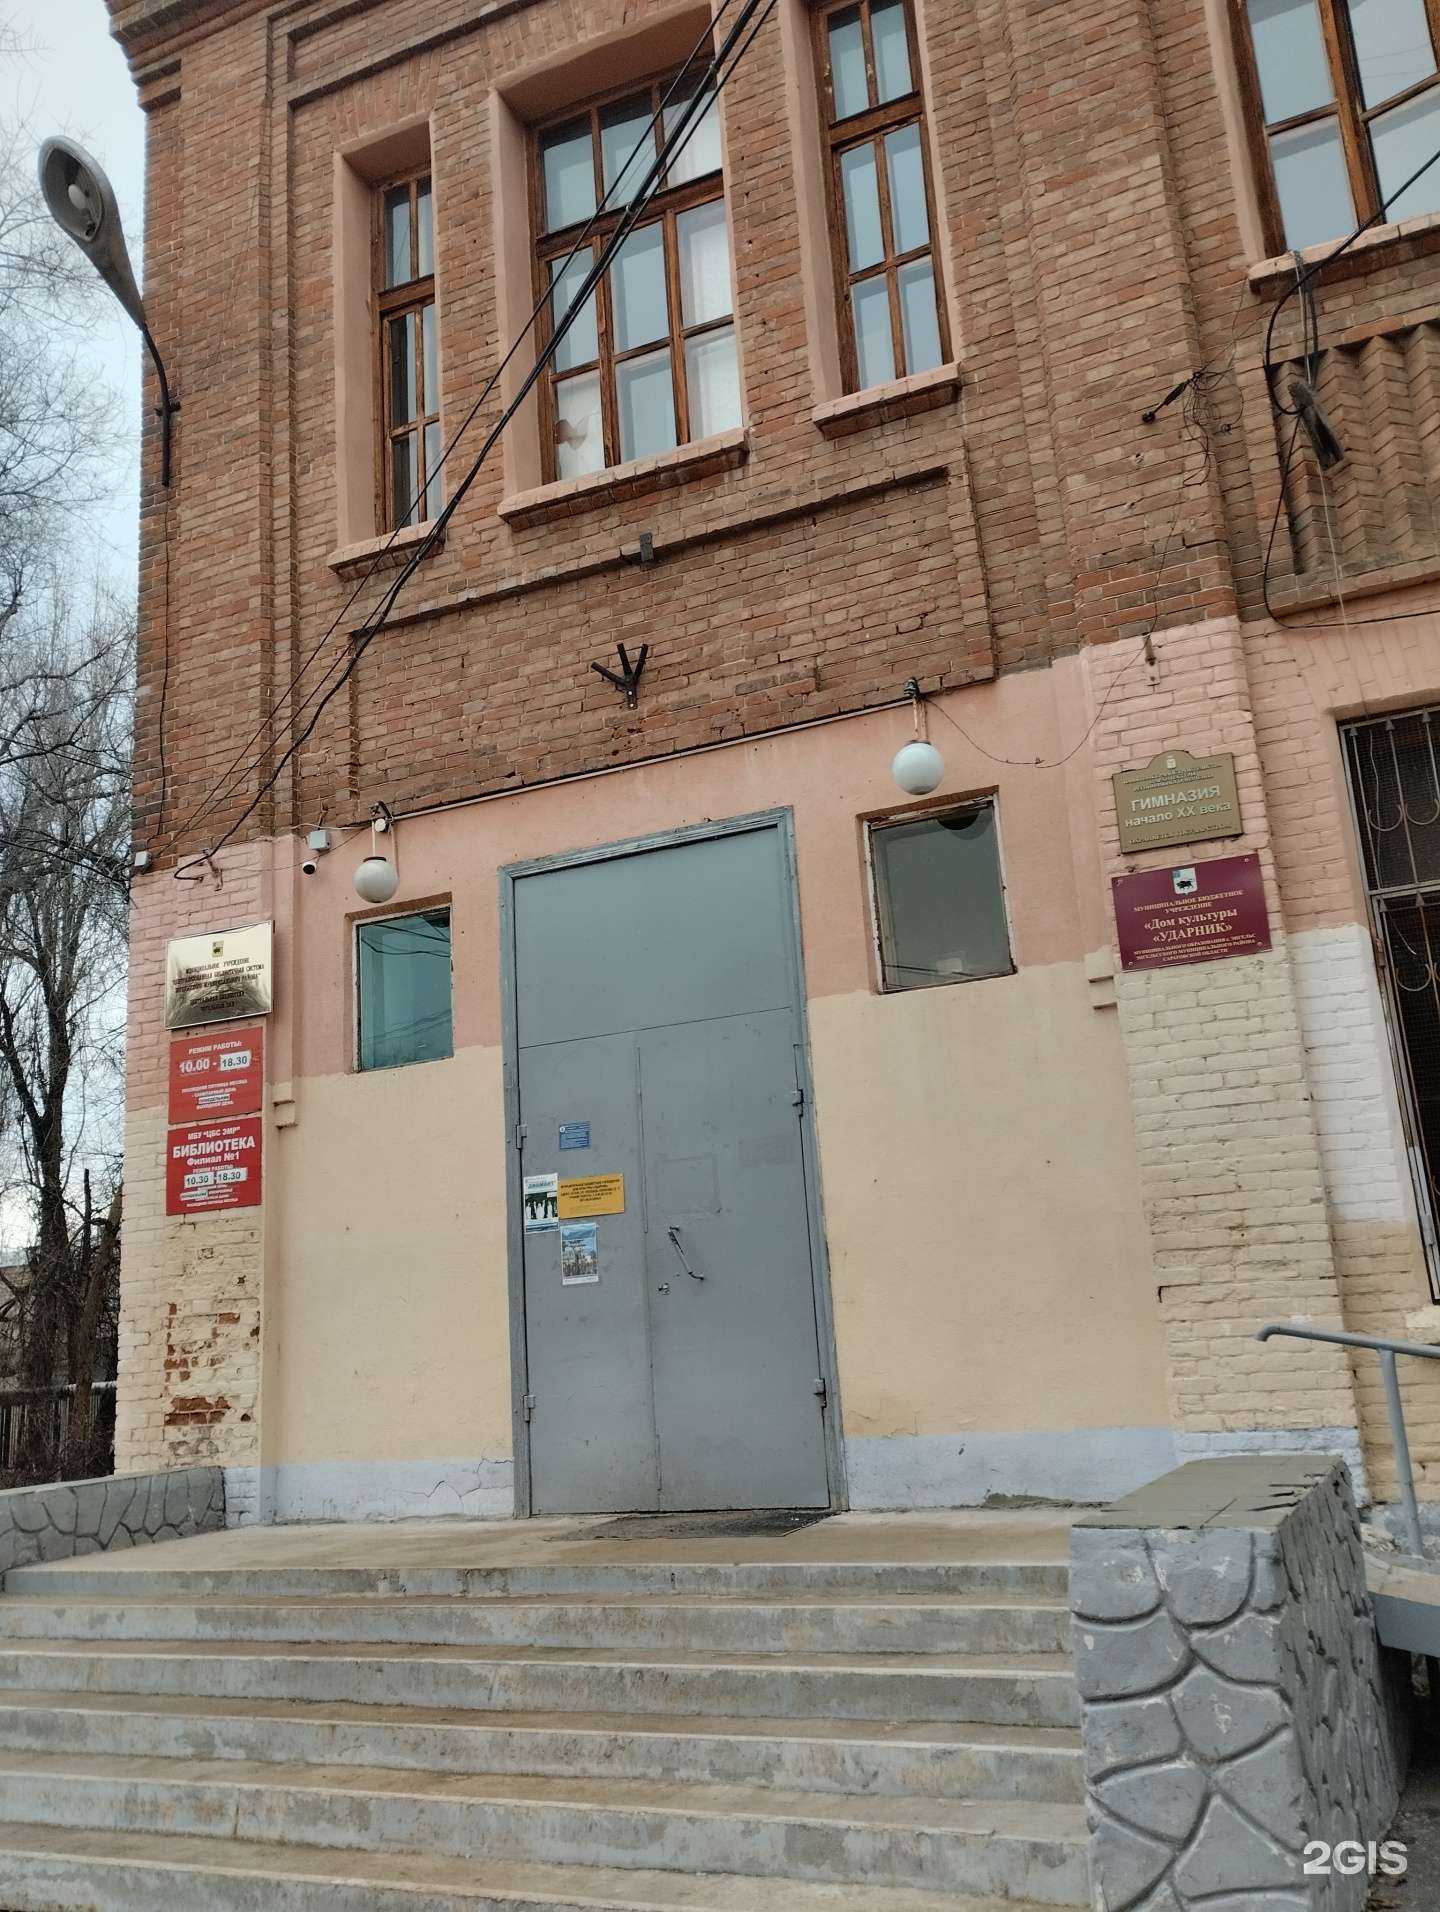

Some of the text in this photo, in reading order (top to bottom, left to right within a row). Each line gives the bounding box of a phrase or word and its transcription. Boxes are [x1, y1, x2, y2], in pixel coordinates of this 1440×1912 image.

[1131, 785, 1221, 811] ГИМНАЗИЯ
[1125, 812, 1173, 827] начало
[1200, 802, 1232, 815] века
[1144, 909, 1238, 931] «Дом культуры
[1153, 922, 1233, 943] «УДАРНИК»
[188, 1045, 212, 1055] РЕЖИМ
[179, 1058, 210, 1073] 10.00
[222, 1055, 248, 1068] 18.30
[188, 1131, 201, 1140] МБУ
[173, 1136, 256, 1158] БИБЛИОТЕКА
[187, 1151, 240, 1166] Филиал №1
[187, 1175, 209, 1186] 10.30
[219, 1171, 241, 1181] 18.30
